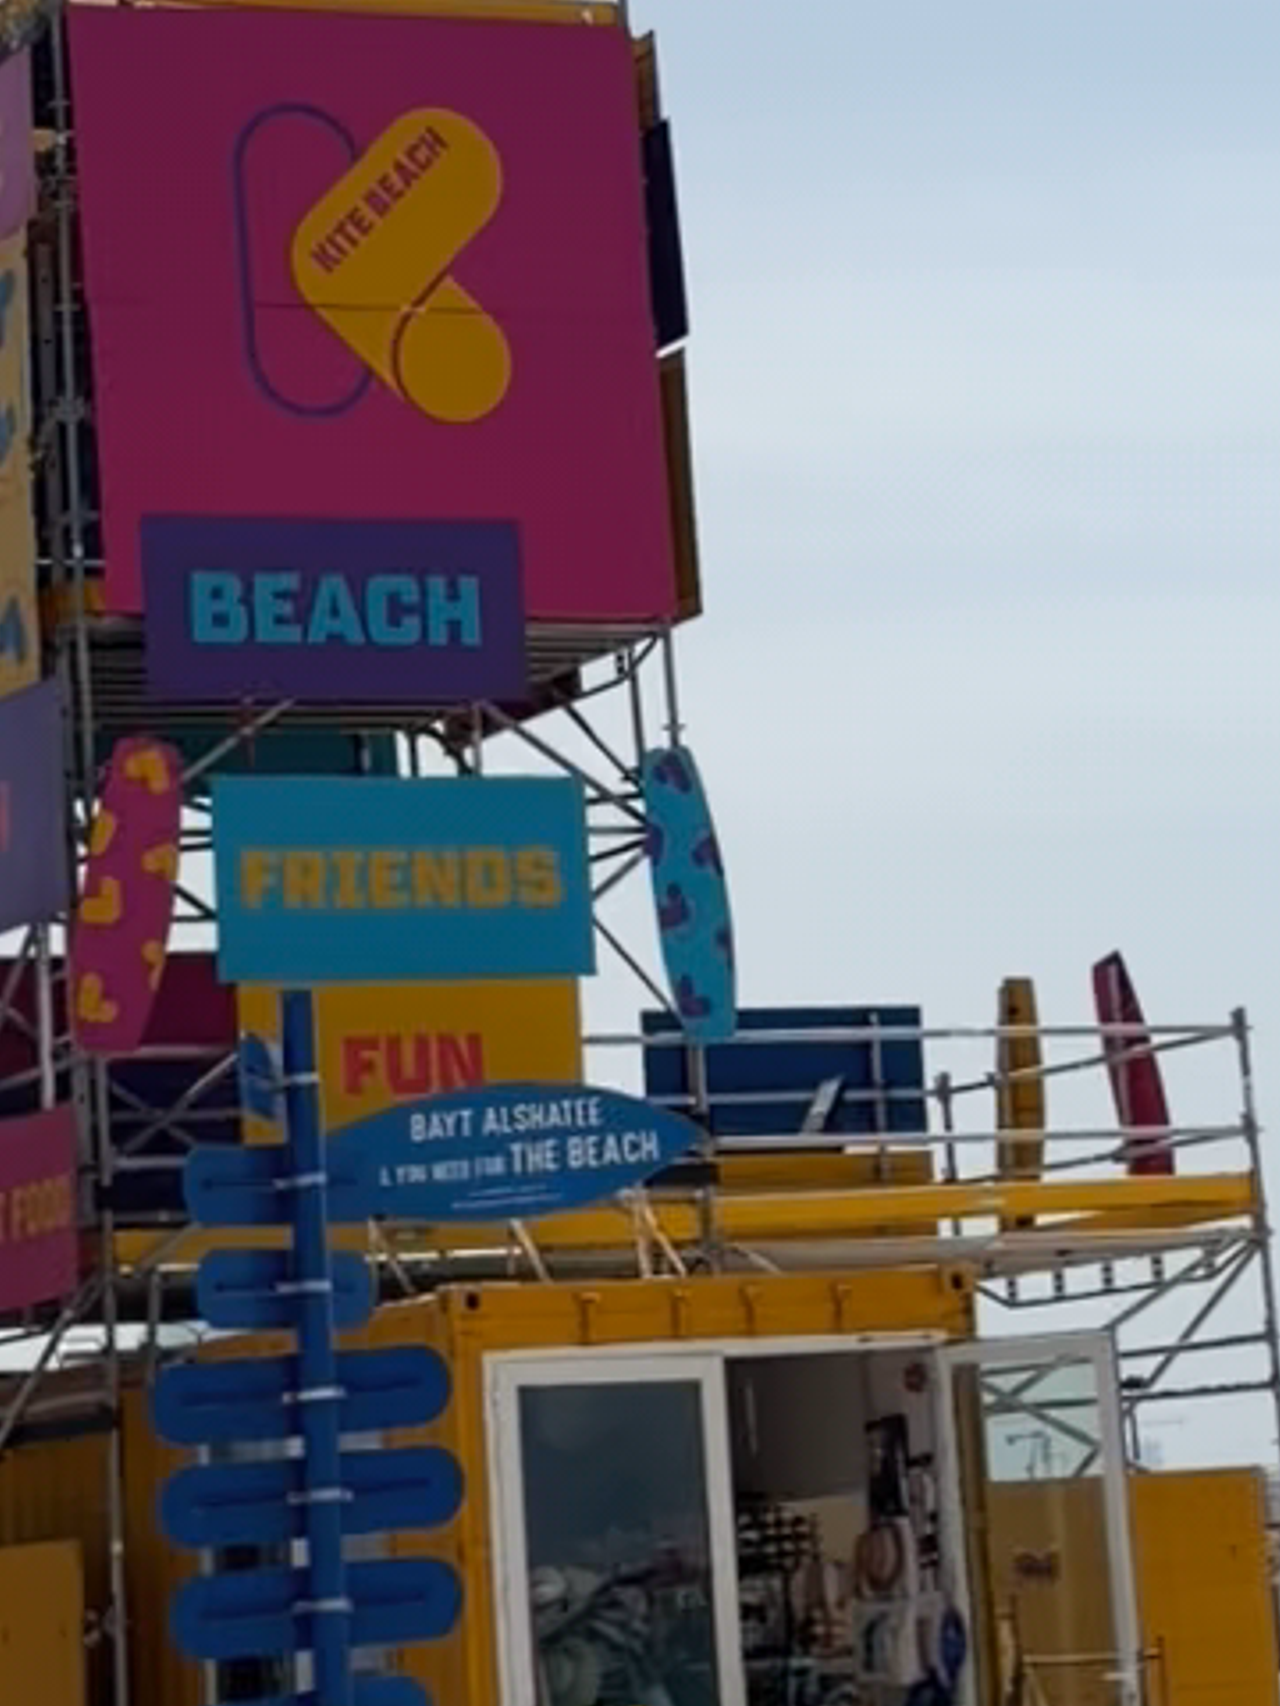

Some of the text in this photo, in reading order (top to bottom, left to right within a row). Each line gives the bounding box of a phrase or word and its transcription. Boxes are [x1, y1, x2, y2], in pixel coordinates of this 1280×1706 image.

[309, 124, 450, 275] KITE BEACH
[190, 571, 482, 647] BEACH
[239, 849, 563, 910] FRIENDS
[338, 1032, 484, 1096] FUN
[409, 1096, 605, 1142] BAYT ALSHATEE
[431, 1159, 470, 1181] NEED
[509, 1139, 559, 1175] THE
[568, 1129, 660, 1170] BEACH
